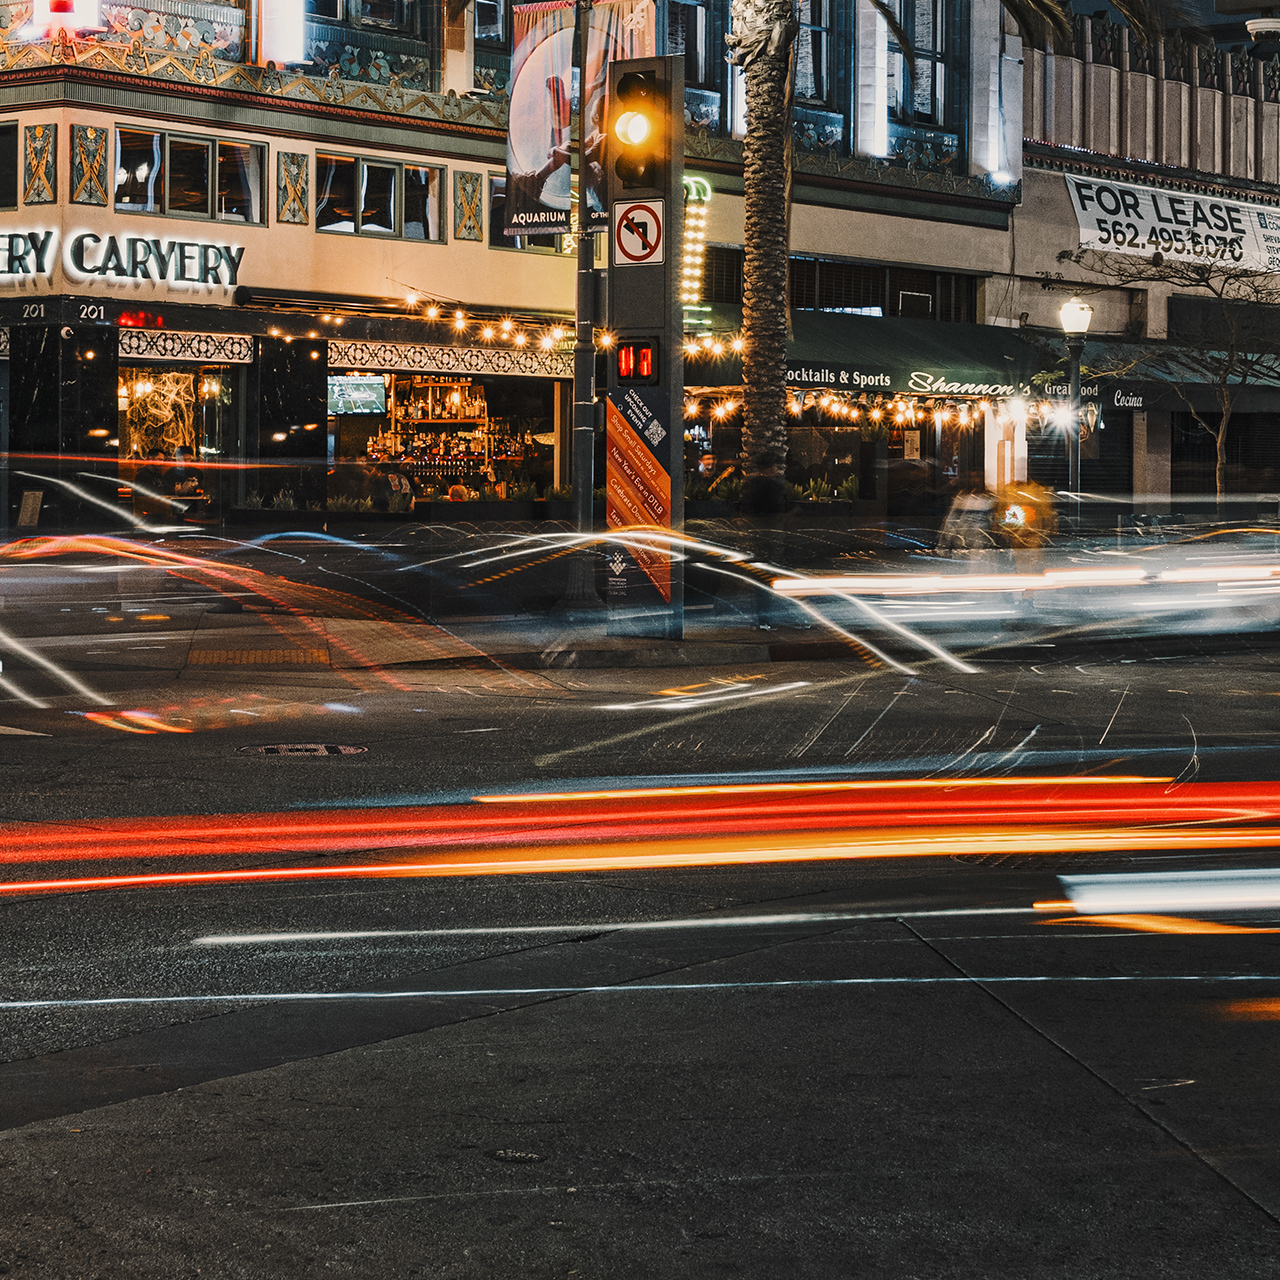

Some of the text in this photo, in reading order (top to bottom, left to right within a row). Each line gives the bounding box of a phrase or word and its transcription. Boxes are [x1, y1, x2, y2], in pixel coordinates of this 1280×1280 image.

[511, 212, 566, 226] AQUARIUM
[1074, 181, 1143, 220] FOR
[1150, 194, 1247, 235] LEASE
[70, 233, 245, 285] CARVERY
[22, 304, 45, 318] 201
[79, 304, 105, 320] 201
[786, 368, 891, 388] ocktails & Sports
[908, 371, 1031, 396] Shannon's
[1080, 384, 1098, 396] ood
[1114, 389, 1144, 407] Cocina
[624, 394, 647, 423] UPCOMING
[629, 389, 653, 418] CHECK OUT
[627, 409, 643, 429] EVENTS
[611, 414, 656, 475] Shop Small Saturdays
[611, 446, 663, 514] New Year's Eve in DTLB
[610, 478, 632, 508] Celebrate
[610, 509, 623, 527] Taste
